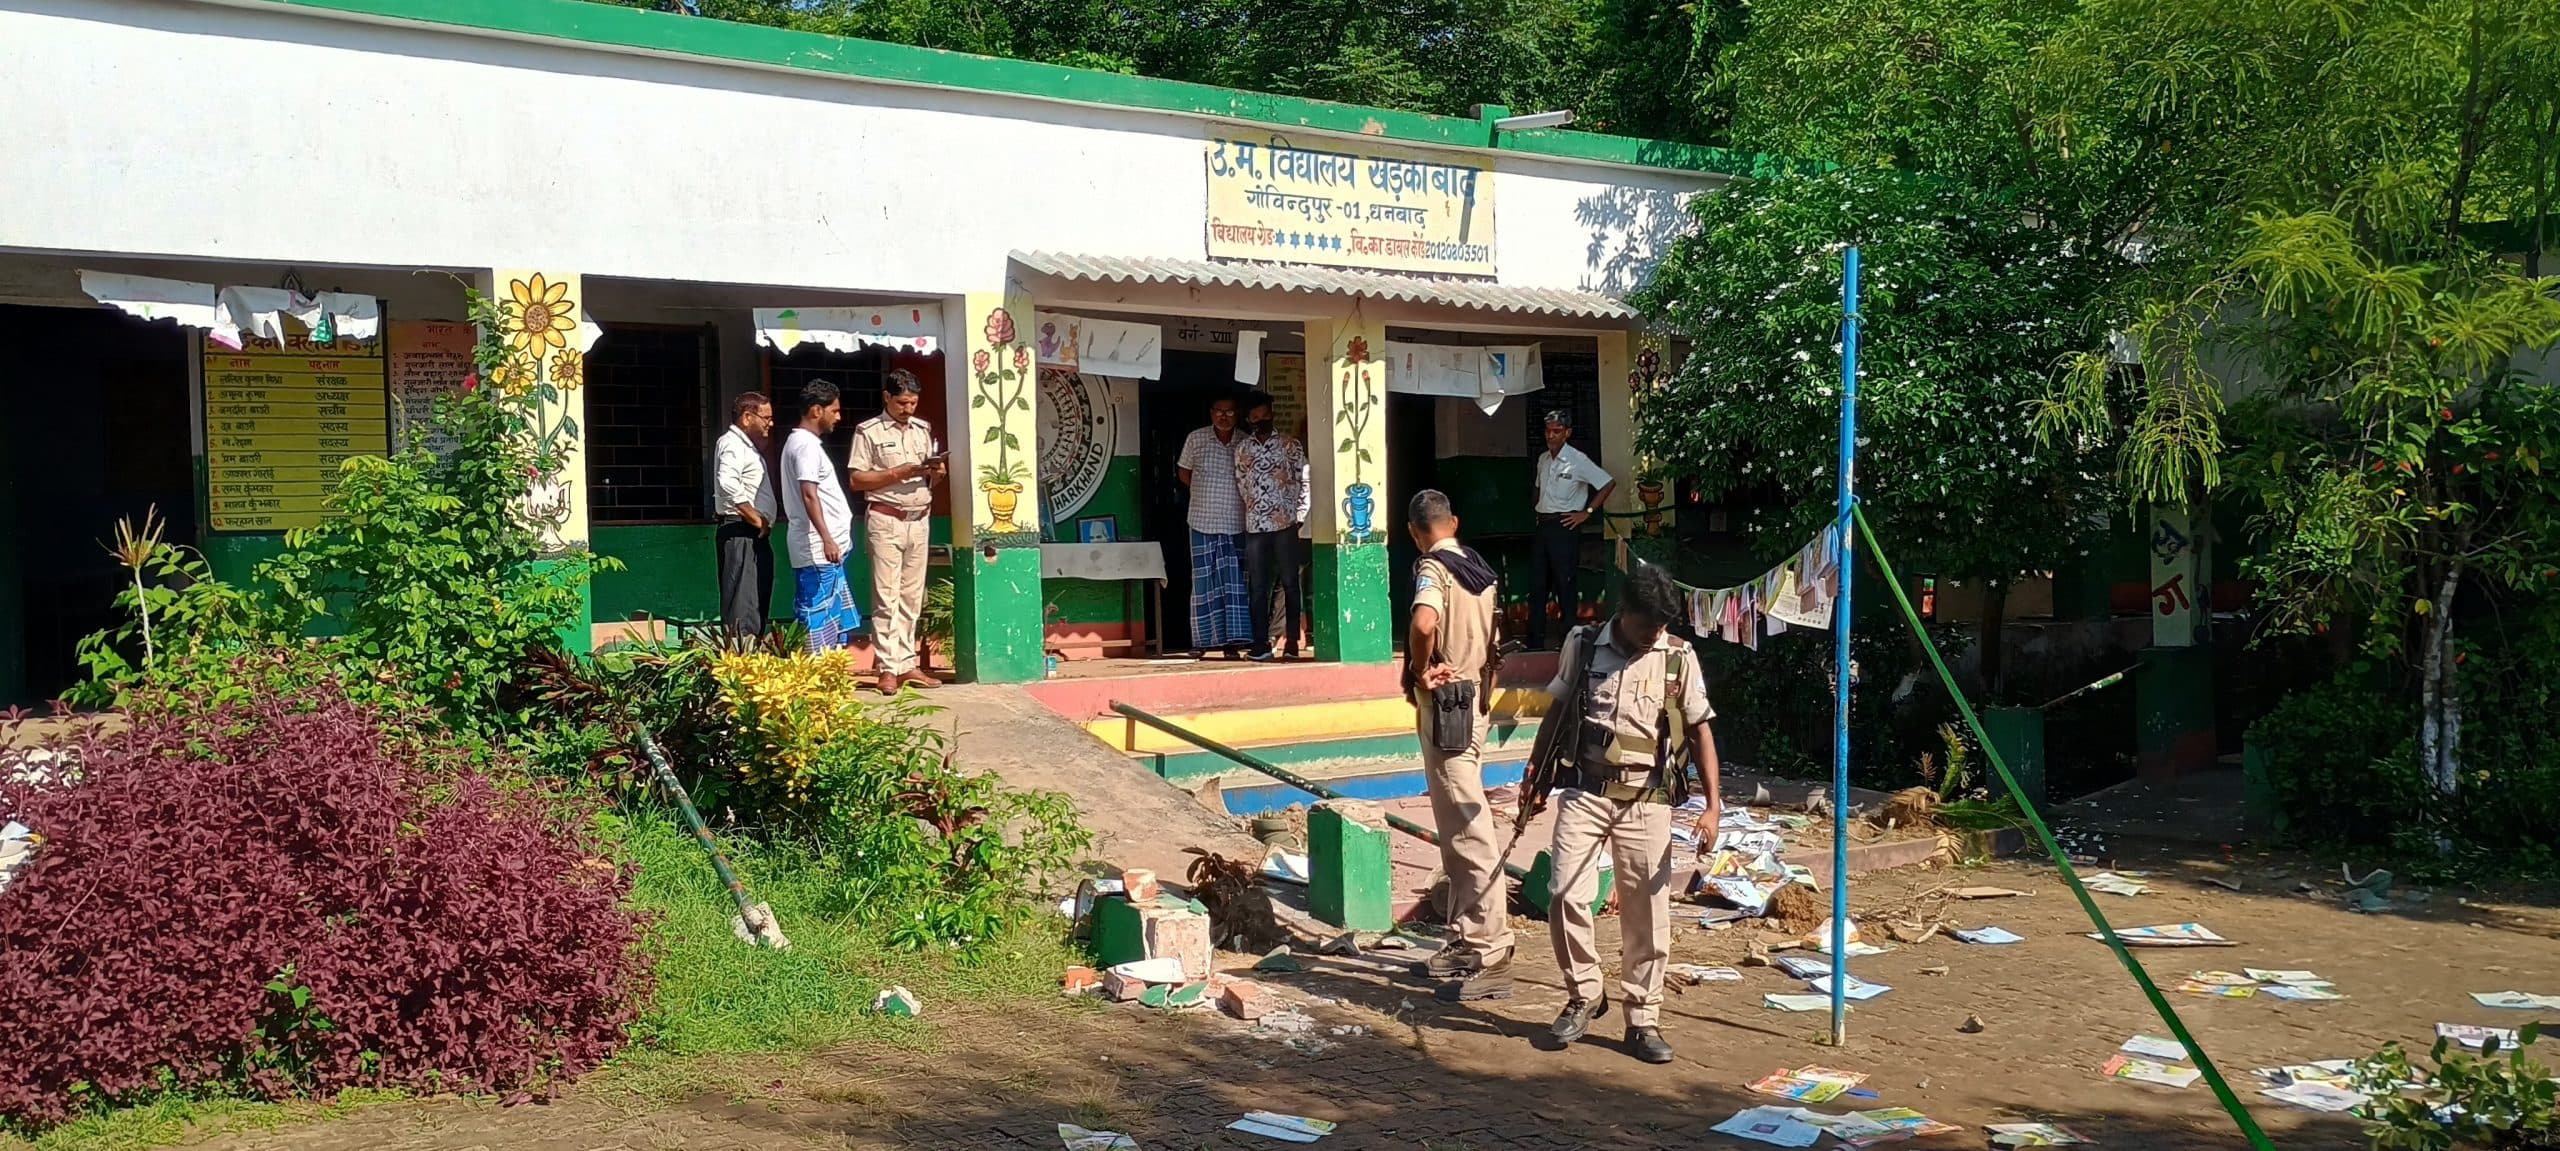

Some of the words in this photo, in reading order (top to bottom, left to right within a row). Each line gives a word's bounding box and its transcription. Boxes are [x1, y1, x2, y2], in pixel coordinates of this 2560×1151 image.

[1265, 134, 1359, 189] विद्यालय
[1244, 185, 1333, 223] गोविन्दपुर
[1211, 217, 1256, 246] विद्यालय
[1425, 240, 1489, 262] 20120803501
[1210, 330, 1233, 344] VIII
[229, 358, 252, 370] नाम
[319, 422, 349, 433] सदस्य
[318, 438, 350, 448] सदस्य
